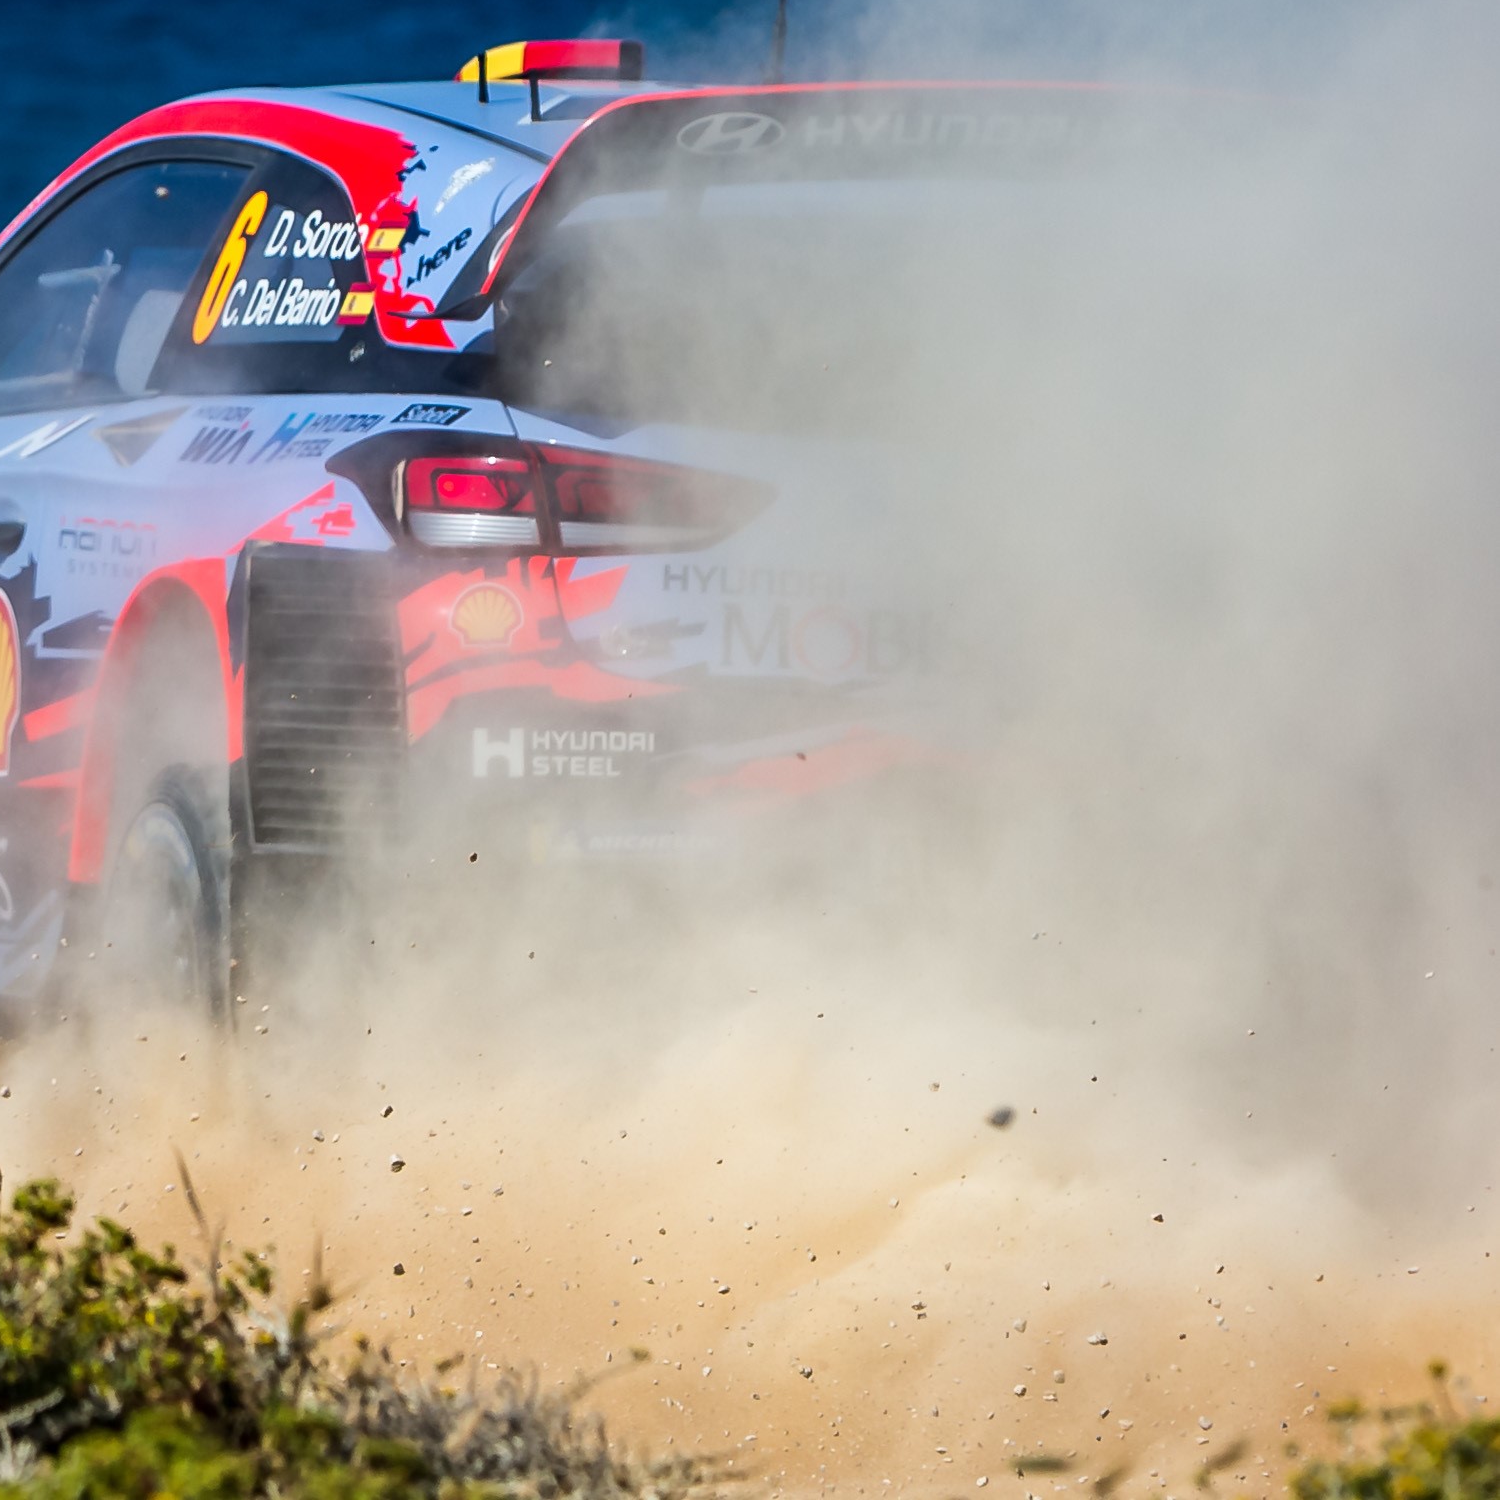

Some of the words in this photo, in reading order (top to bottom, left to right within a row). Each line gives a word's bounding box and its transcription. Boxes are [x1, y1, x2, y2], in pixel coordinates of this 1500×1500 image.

[264, 209, 296, 257] D.
[293, 209, 370, 262] Sordo
[416, 227, 473, 282] here
[191, 190, 269, 345] 6
[220, 278, 248, 328] C.
[242, 278, 284, 327] Del
[275, 278, 342, 327] Barrio
[715, 602, 968, 678] MOBI
[531, 729, 656, 754] HYUNDAI
[531, 755, 623, 778] STEEL
